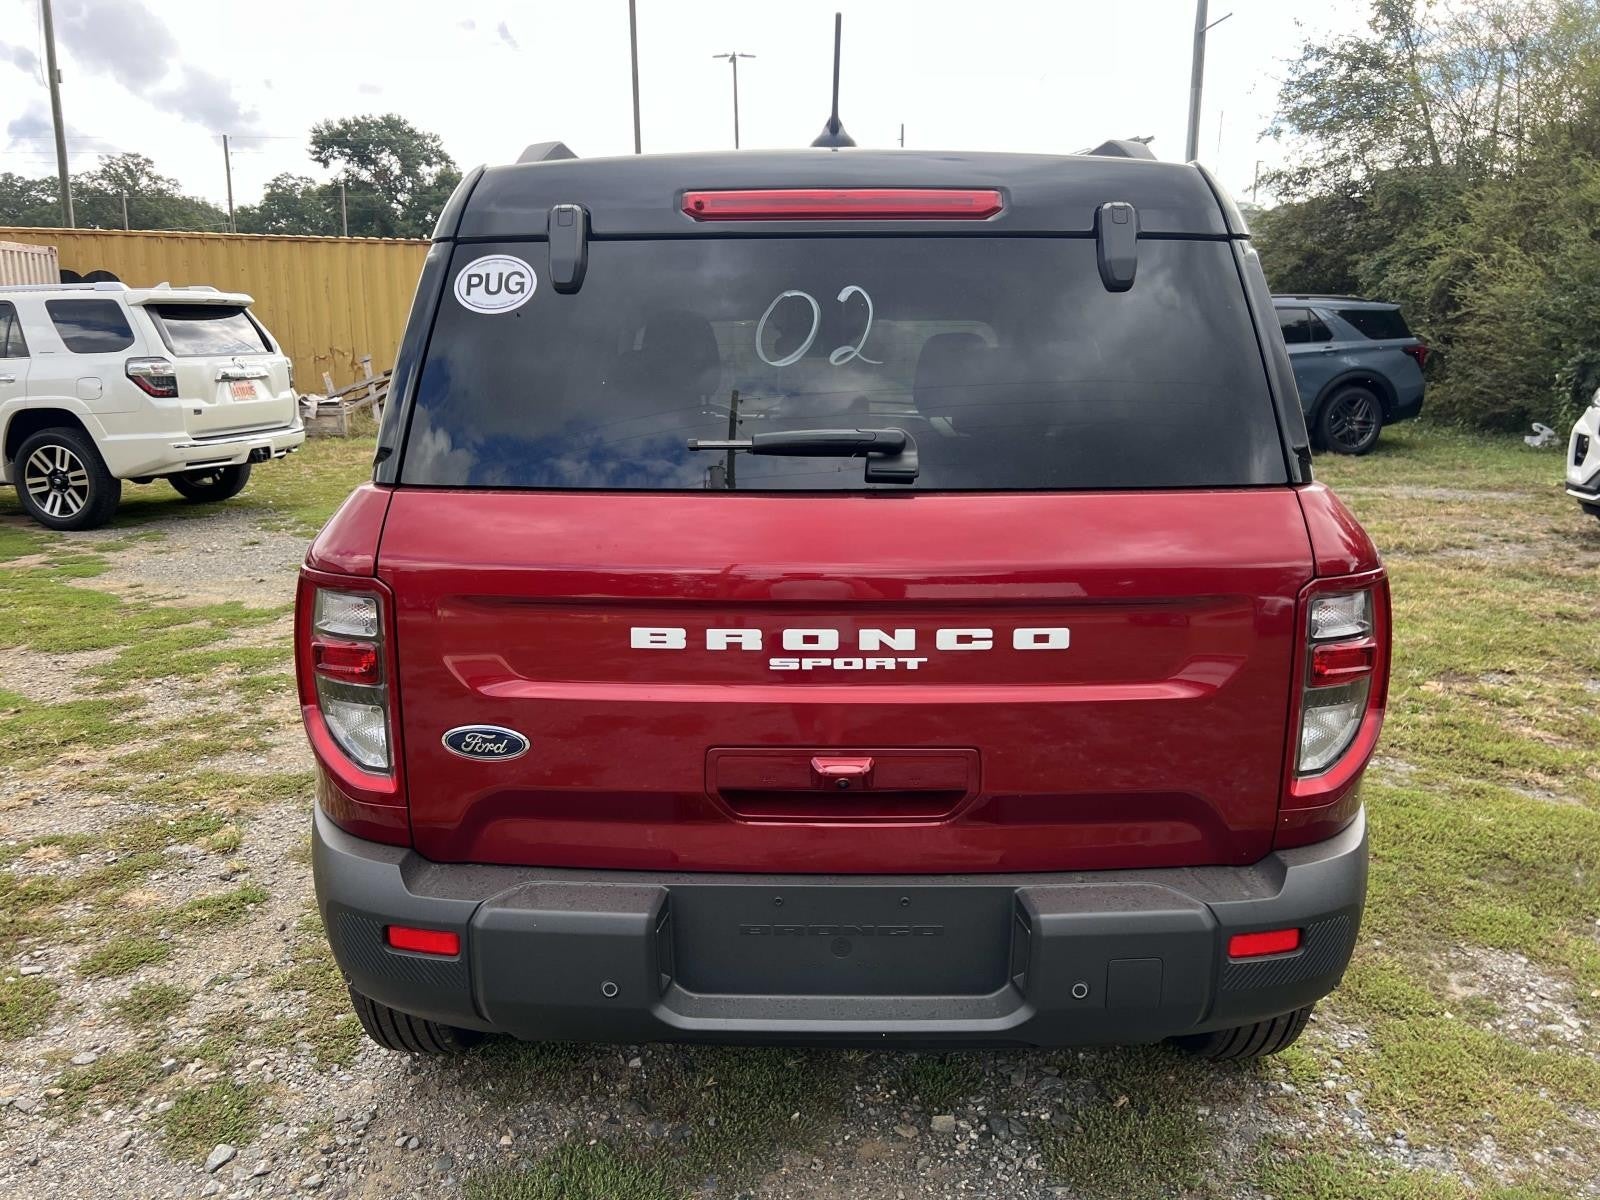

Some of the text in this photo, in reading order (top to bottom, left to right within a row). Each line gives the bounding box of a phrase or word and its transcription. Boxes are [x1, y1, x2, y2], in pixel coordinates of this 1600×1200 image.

[465, 270, 526, 296] PUG
[755, 285, 884, 367] 02
[630, 627, 1070, 651] BRONCO
[769, 657, 928, 670] SPORT
[461, 732, 508, 753] Ford
[739, 923, 945, 937] BRONCO
